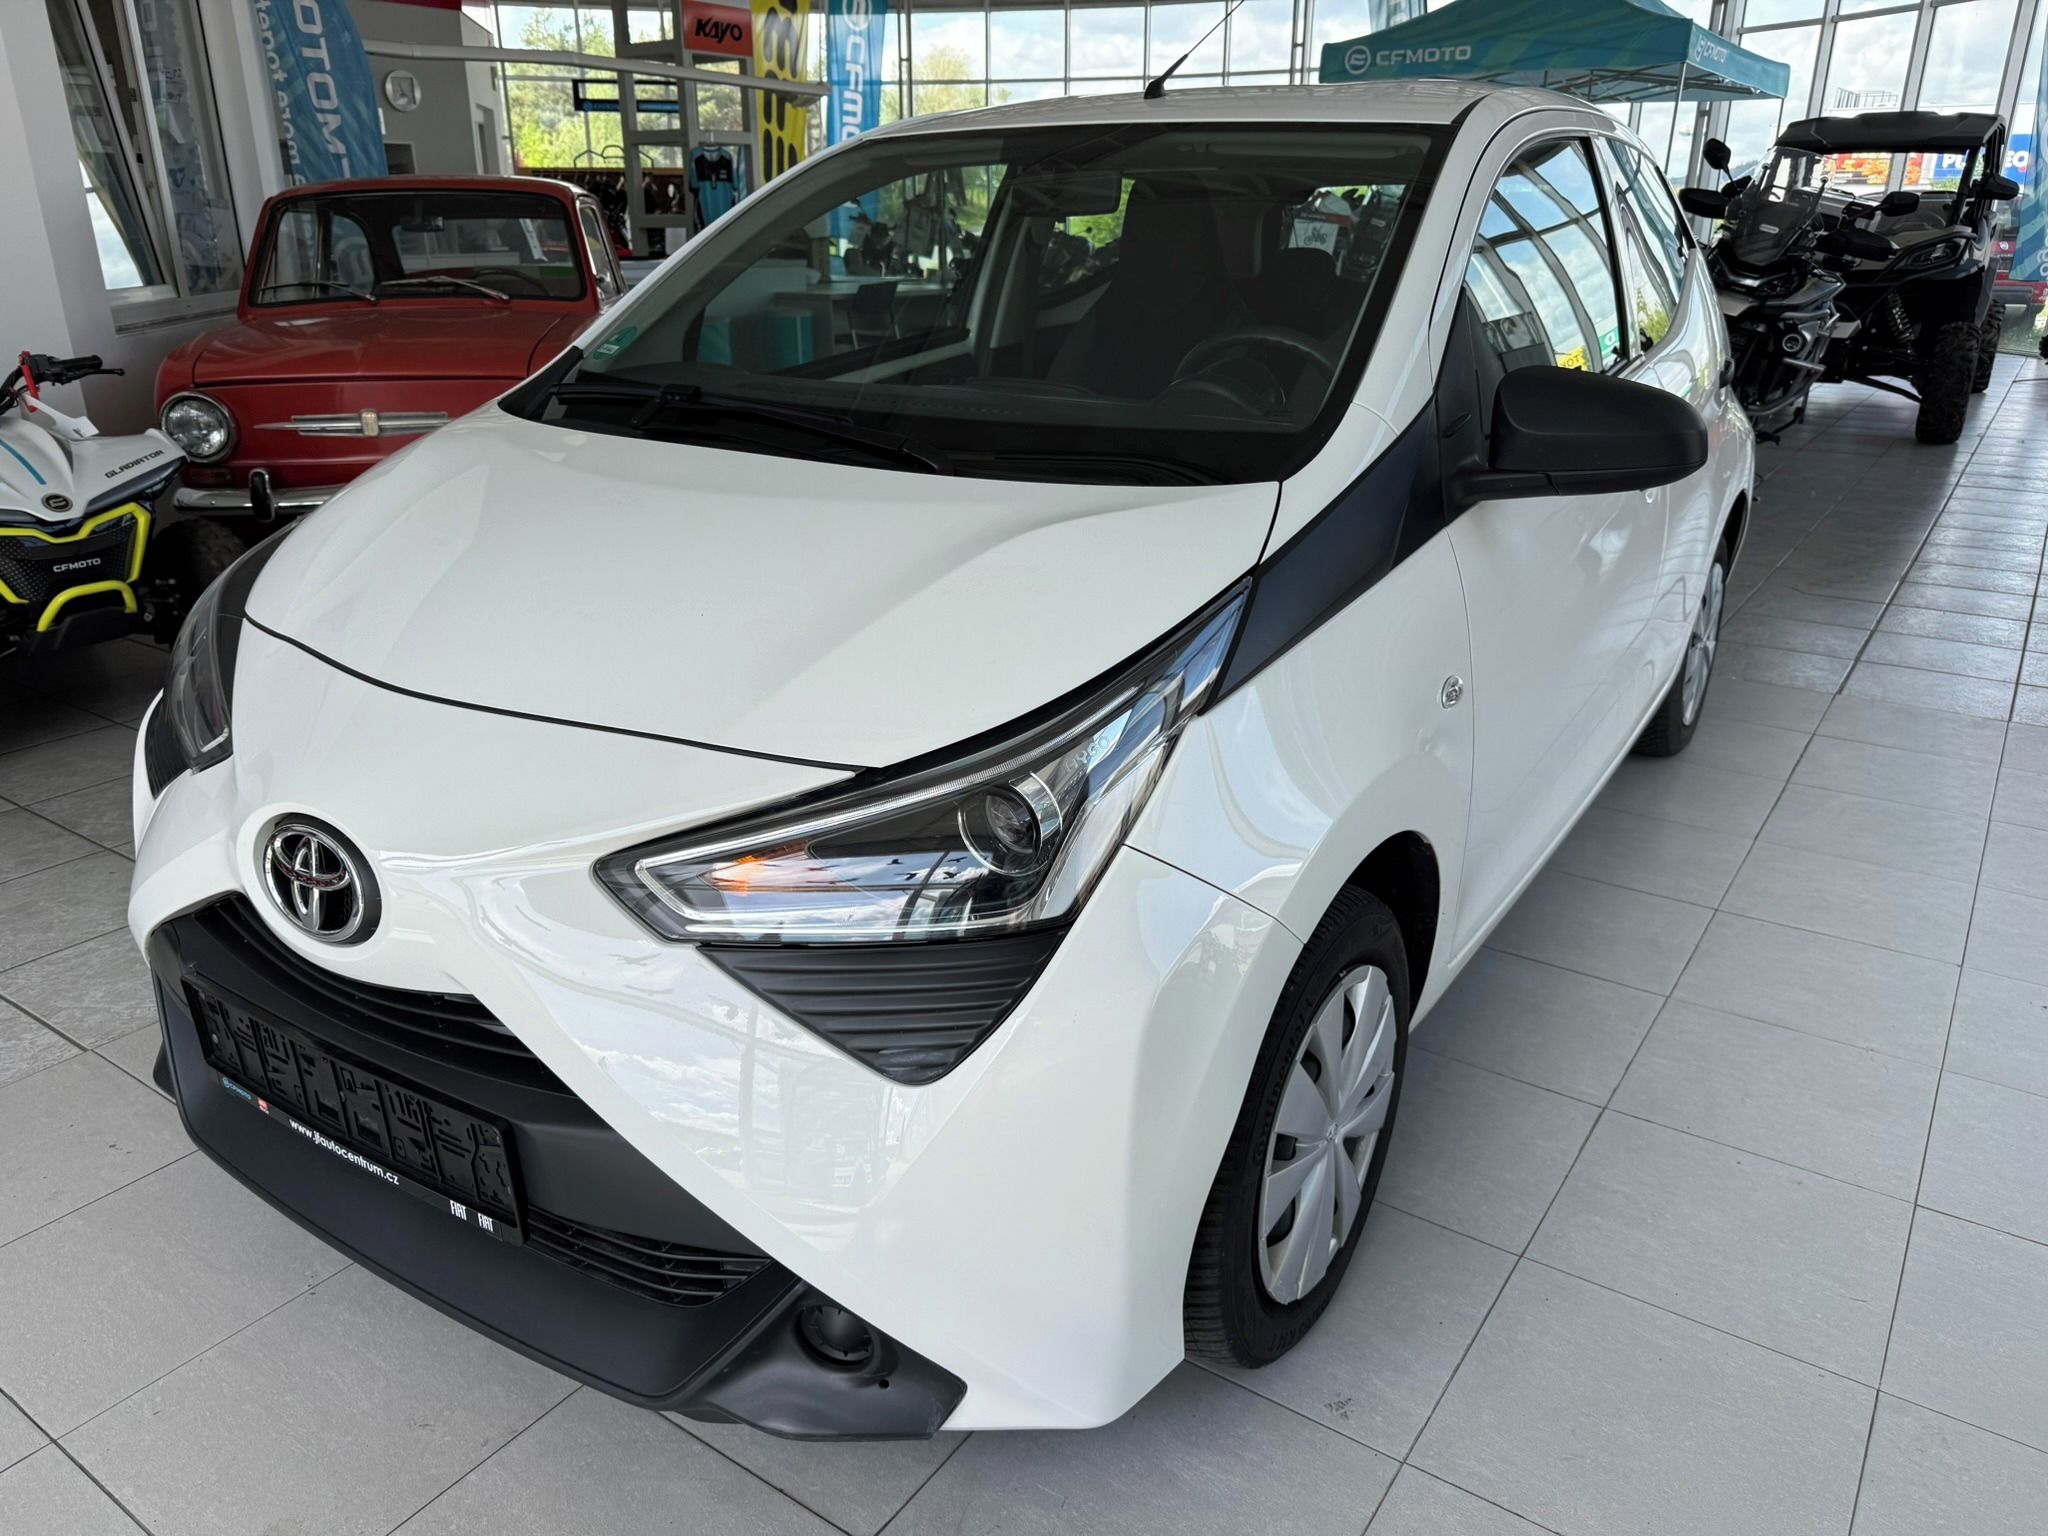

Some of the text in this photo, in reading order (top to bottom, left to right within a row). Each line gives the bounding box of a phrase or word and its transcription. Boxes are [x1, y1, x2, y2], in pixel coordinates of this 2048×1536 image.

[1375, 45, 1472, 66] CFMOTO
[841, 35, 866, 141] CFMO
[104, 449, 165, 479] GLADIATOR
[53, 557, 101, 573] CFMOTO
[450, 1200, 494, 1232] FIAT FIAT
